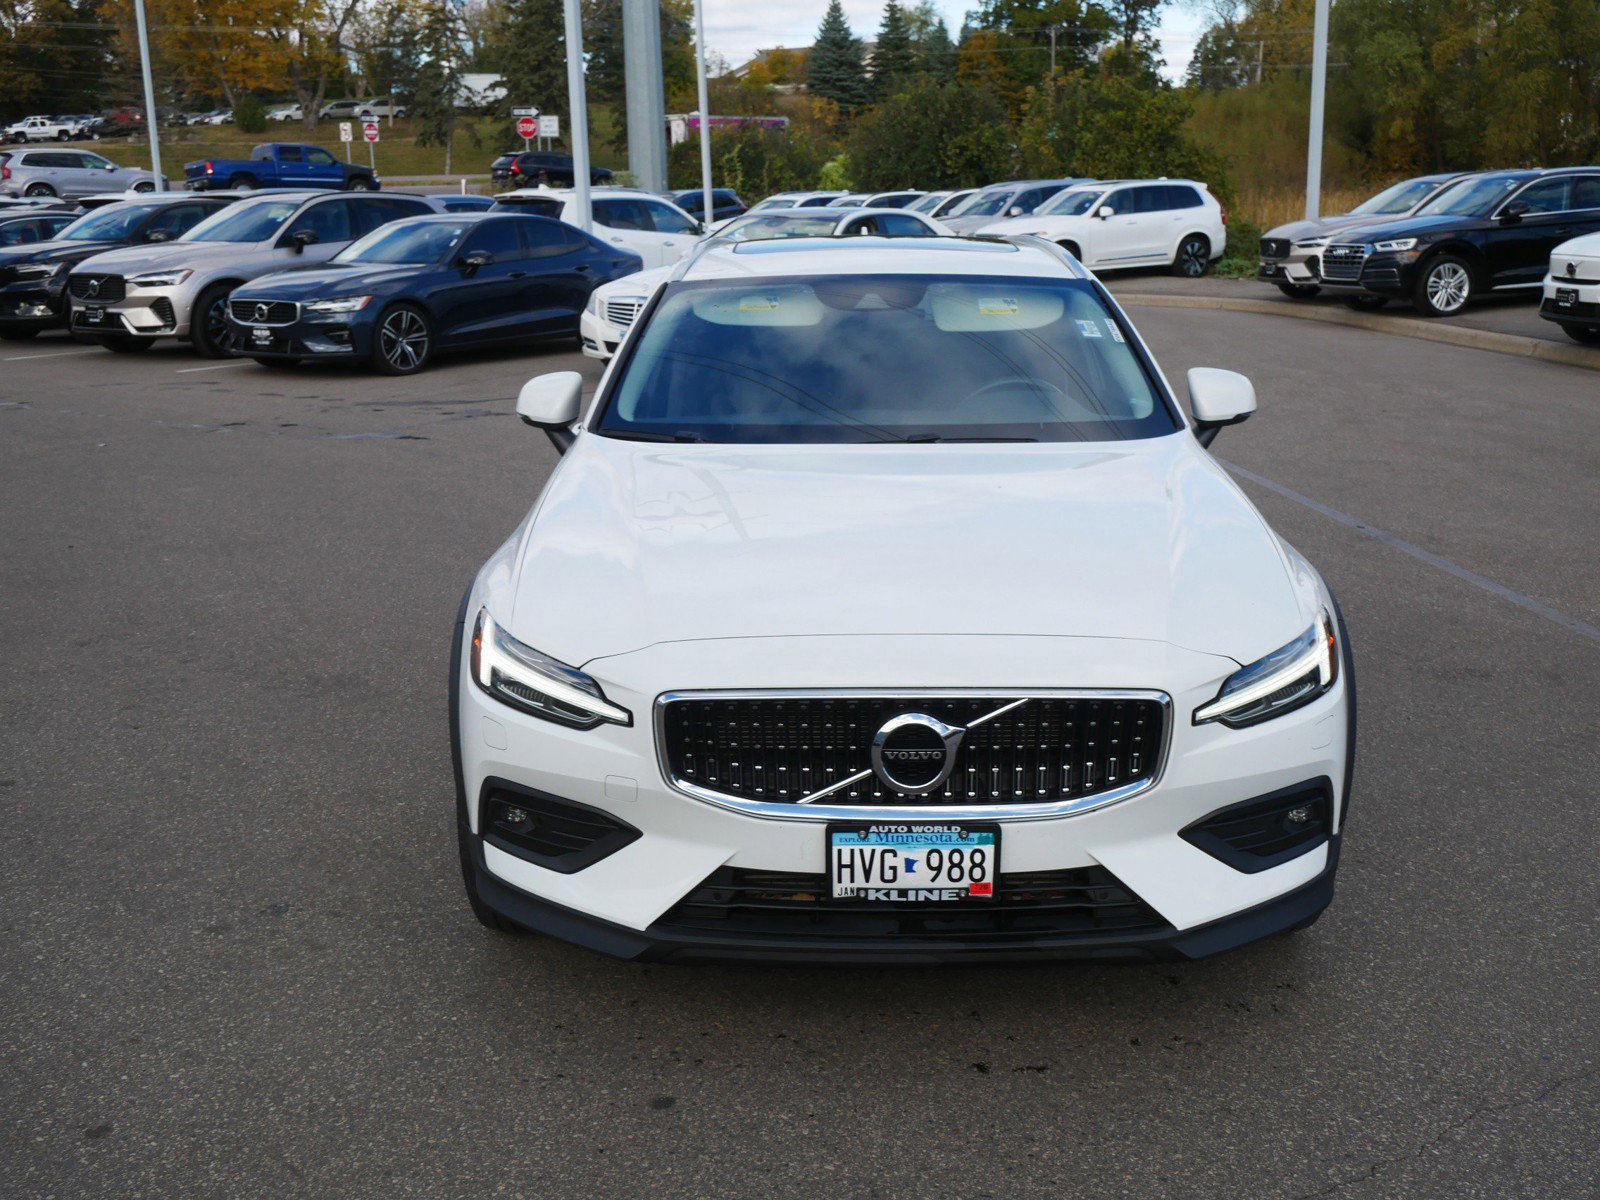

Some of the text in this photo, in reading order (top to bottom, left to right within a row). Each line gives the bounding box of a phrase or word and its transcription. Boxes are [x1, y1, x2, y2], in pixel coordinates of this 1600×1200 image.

[518, 123, 537, 132] STOP
[884, 751, 942, 760] VOLVO
[869, 825, 961, 833] AUTO WORLD
[837, 848, 986, 884] HVG 988
[837, 886, 855, 897] JAN
[867, 889, 960, 901] KLINE
